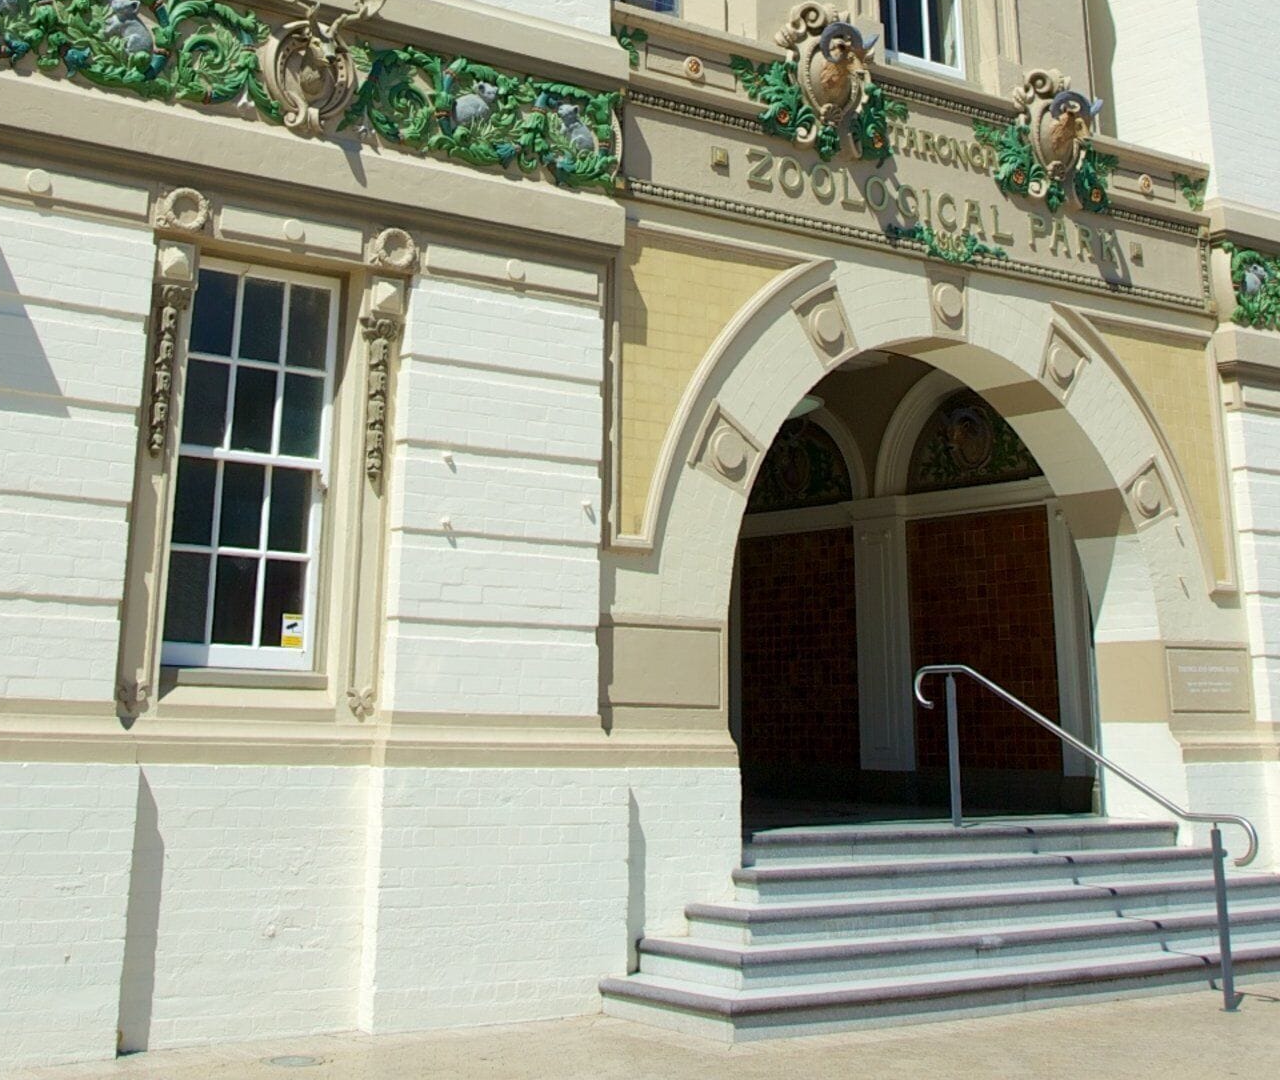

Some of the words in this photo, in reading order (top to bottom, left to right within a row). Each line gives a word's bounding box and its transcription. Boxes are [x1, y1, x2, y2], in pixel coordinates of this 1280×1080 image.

[888, 123, 1000, 172] TARONGA
[746, 148, 1013, 244] ZOOLOGICAL
[1027, 214, 1124, 264] PARK
